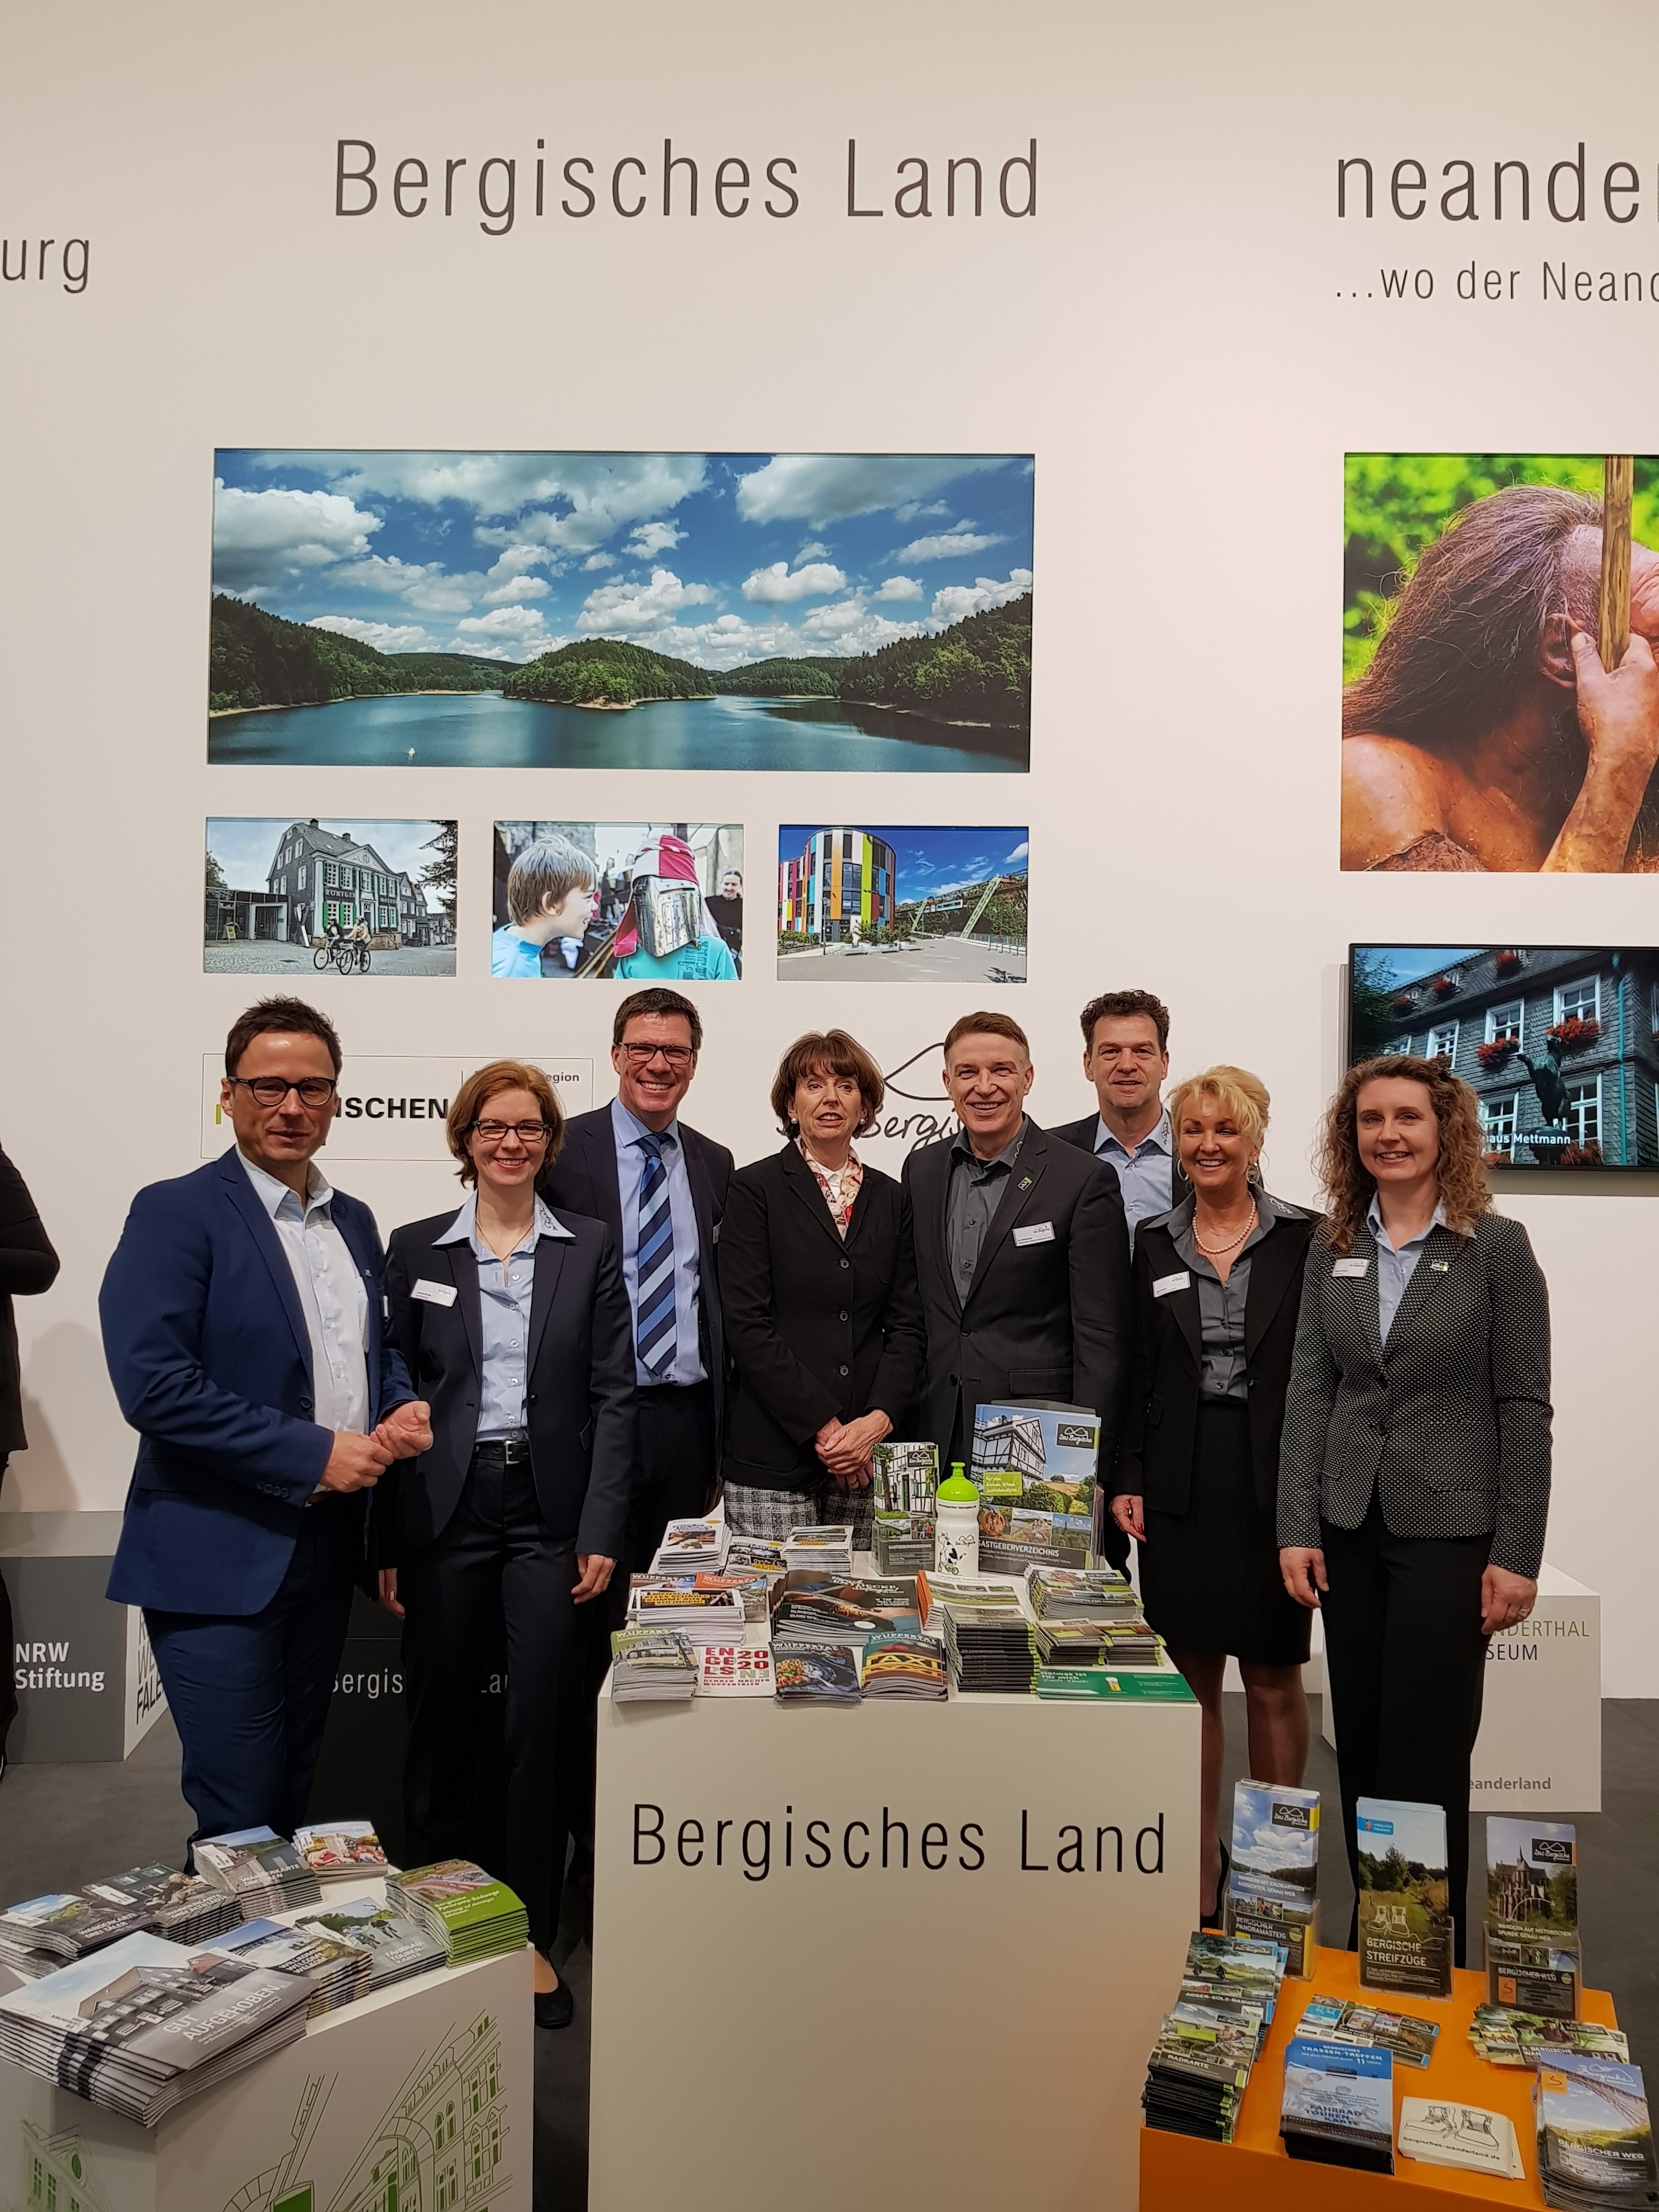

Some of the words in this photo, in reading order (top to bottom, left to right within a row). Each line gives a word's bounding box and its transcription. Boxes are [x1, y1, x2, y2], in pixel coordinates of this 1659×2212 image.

[335, 138, 799, 236] Bergisches
[848, 138, 1037, 218] Land
[1338, 142, 1659, 223] neande
[2, 238, 90, 294] urg
[1336, 268, 1434, 299] ...wo
[1457, 260, 1521, 300] der
[1486, 1133, 1510, 1144] aus
[1513, 1133, 1571, 1144] Mettmann
[15, 1642, 69, 1663] NRW
[1485, 1644, 1538, 1661] SEUM
[866, 1654, 938, 1669] TAXI
[14, 1667, 105, 1691] Stiftung
[136, 1672, 164, 1725] FALE
[1469, 1777, 1551, 1790] eanderland
[631, 1803, 986, 1882] Bergisches
[1020, 1809, 1165, 1874] Land
[77, 1912, 139, 1936] WANDERKARTE
[1235, 1922, 1286, 1939] PANORAMASTEIG
[84, 1929, 104, 1939] DREI
[1366, 1936, 1422, 1953] BERGISCHE
[1366, 1950, 1427, 1967] STREIFZÜGE
[1185, 1991, 1262, 2006] AGGER-SÜLZ-RADWEG
[182, 1984, 285, 2041] AUFGEHOBEN.
[162, 2013, 199, 2033] GUT
[1167, 2054, 1210, 2070] RADKARTE
[1301, 2046, 1383, 2061] TRASSEN-TREFFEN
[1305, 2108, 1354, 2120] TOUREN-
[1310, 2104, 1362, 2117] FAHRRAD
[1557, 2137, 1620, 2158] BERGISCHER
